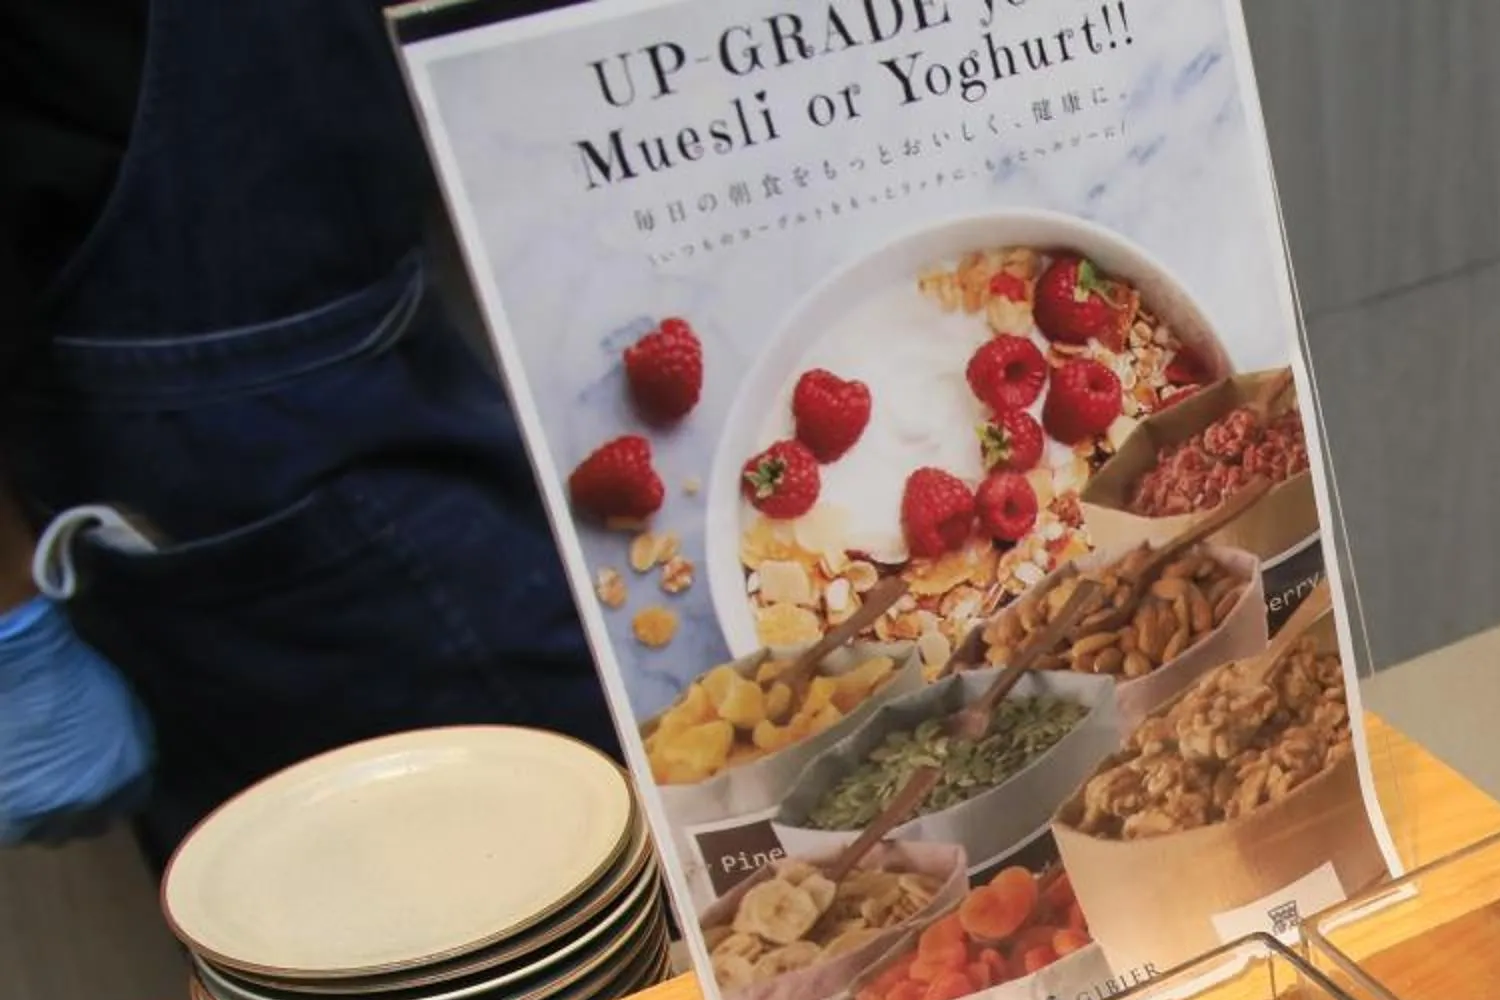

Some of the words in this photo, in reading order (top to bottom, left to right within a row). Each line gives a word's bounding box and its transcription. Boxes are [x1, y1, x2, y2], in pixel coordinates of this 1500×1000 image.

[574, 90, 781, 190] Muesli
[807, 84, 861, 127] or
[878, 0, 1133, 105] Yoghurt!!
[586, 0, 951, 108] UP-GRADE
